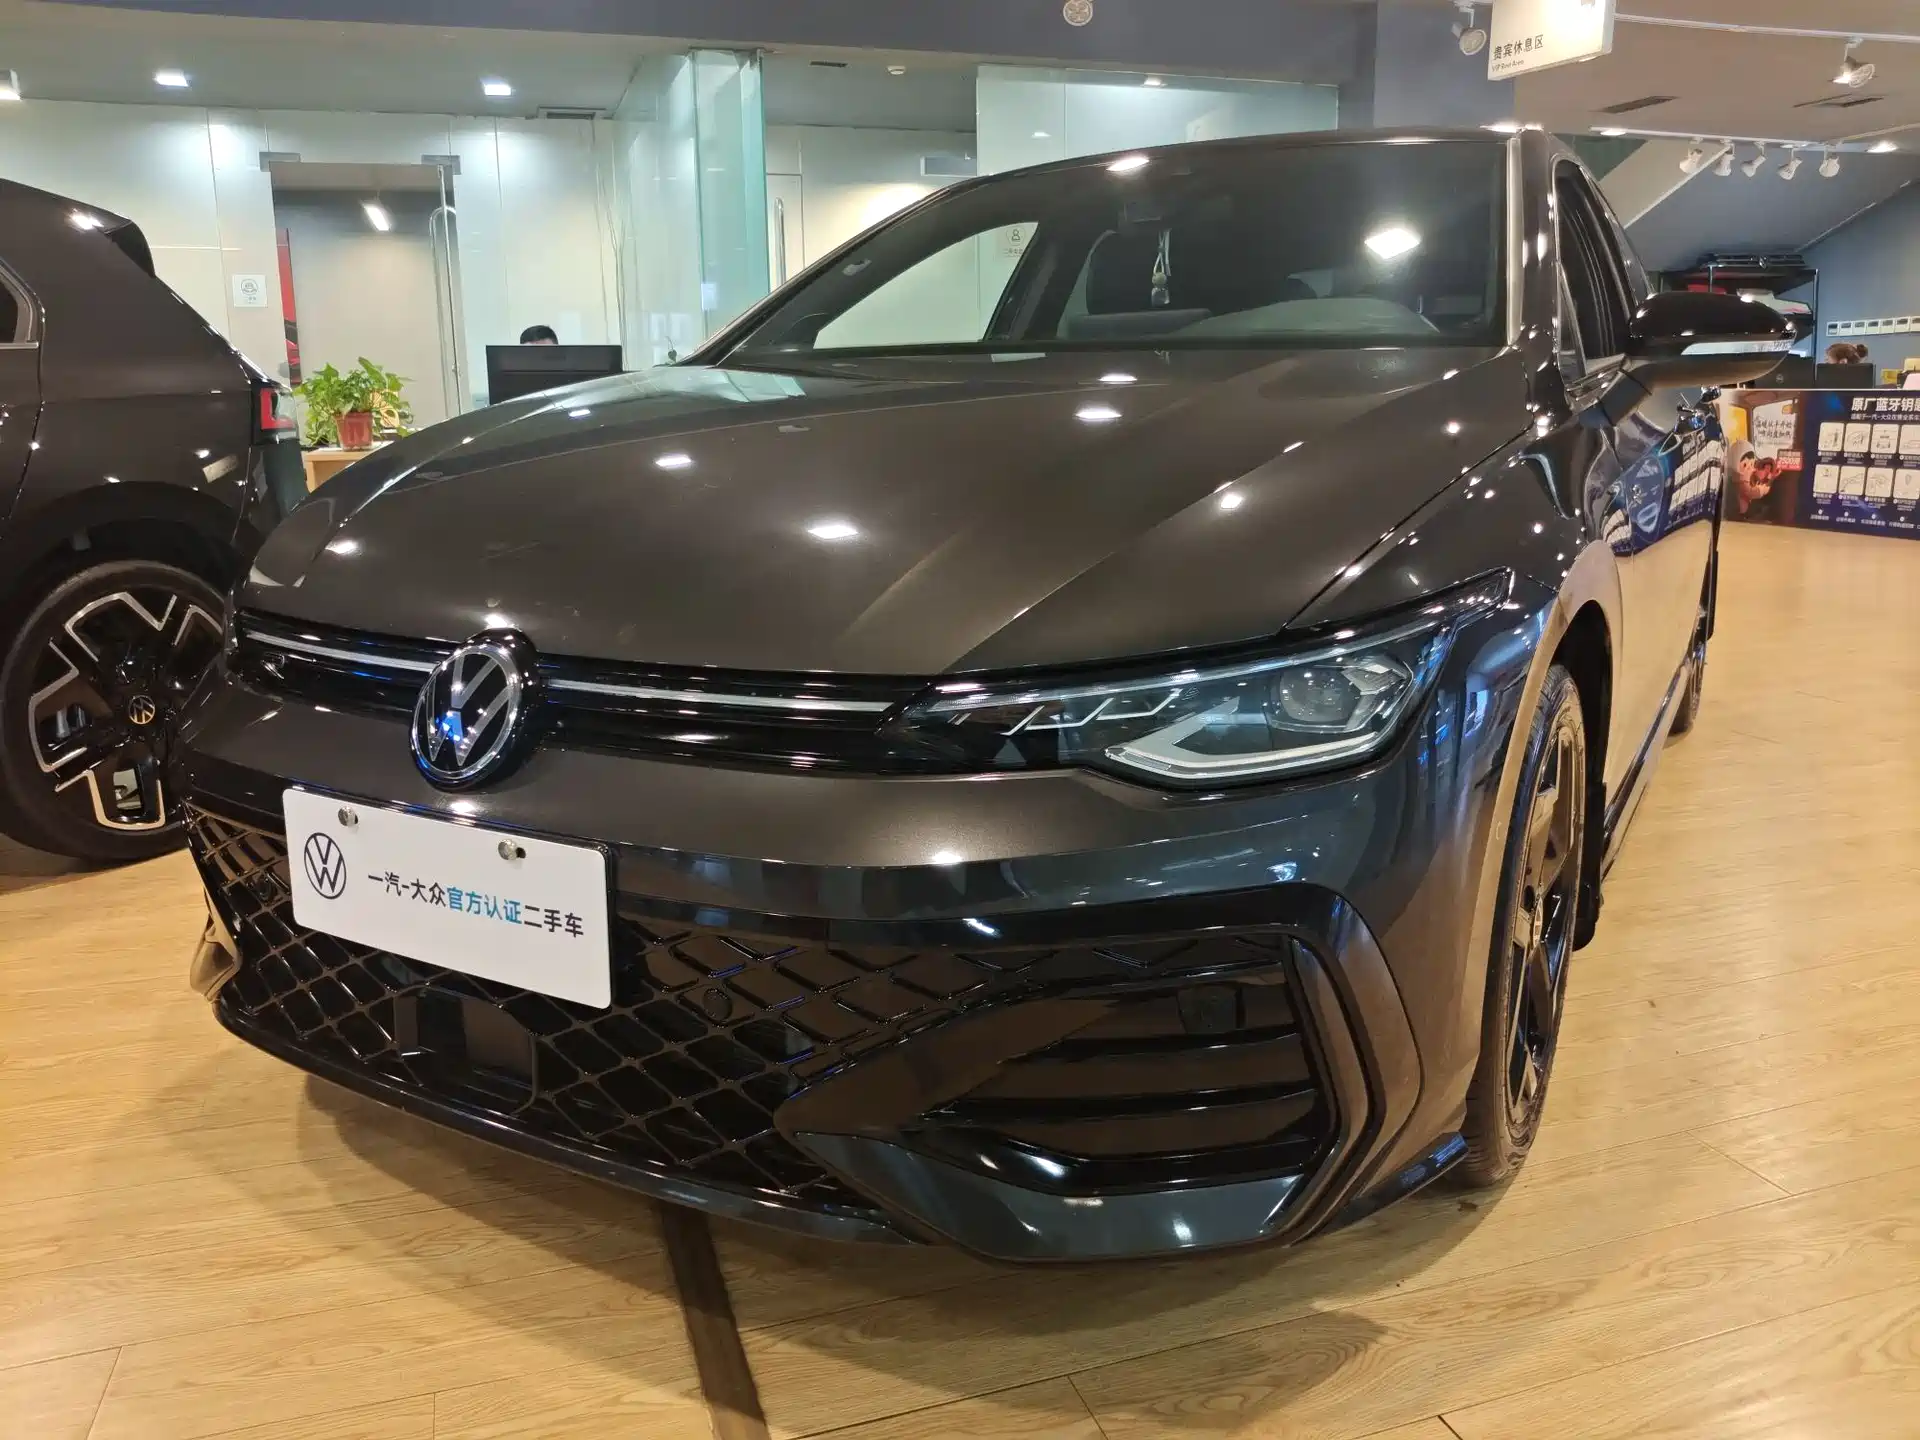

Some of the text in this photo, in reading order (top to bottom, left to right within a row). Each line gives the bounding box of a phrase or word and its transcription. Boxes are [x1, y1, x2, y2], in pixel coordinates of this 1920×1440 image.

[1493, 34, 1544, 60] 贵宾休息区
[367, 871, 584, 938] 一汽-大众官方认证二手车
